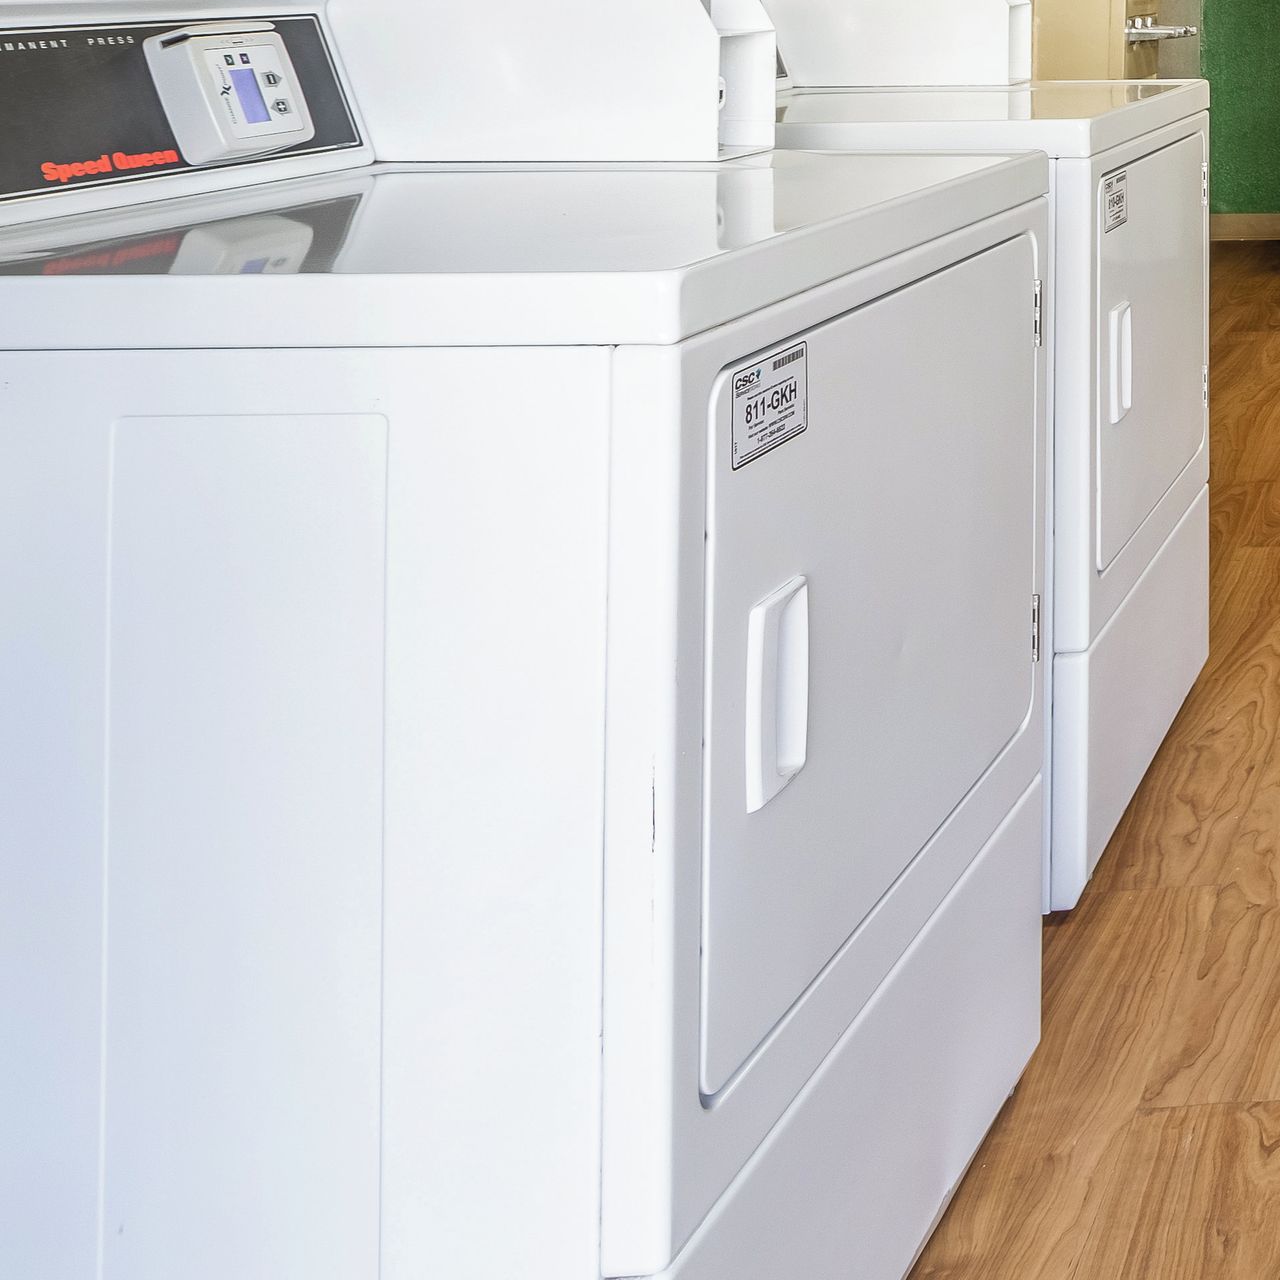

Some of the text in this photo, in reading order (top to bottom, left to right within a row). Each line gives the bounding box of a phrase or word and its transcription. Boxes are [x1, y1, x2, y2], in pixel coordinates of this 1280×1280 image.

[0, 35, 135, 52] MANENT PRESS
[41, 149, 179, 183] Speed Queen
[735, 372, 755, 391] CSC
[745, 380, 797, 424] 811-GKH
